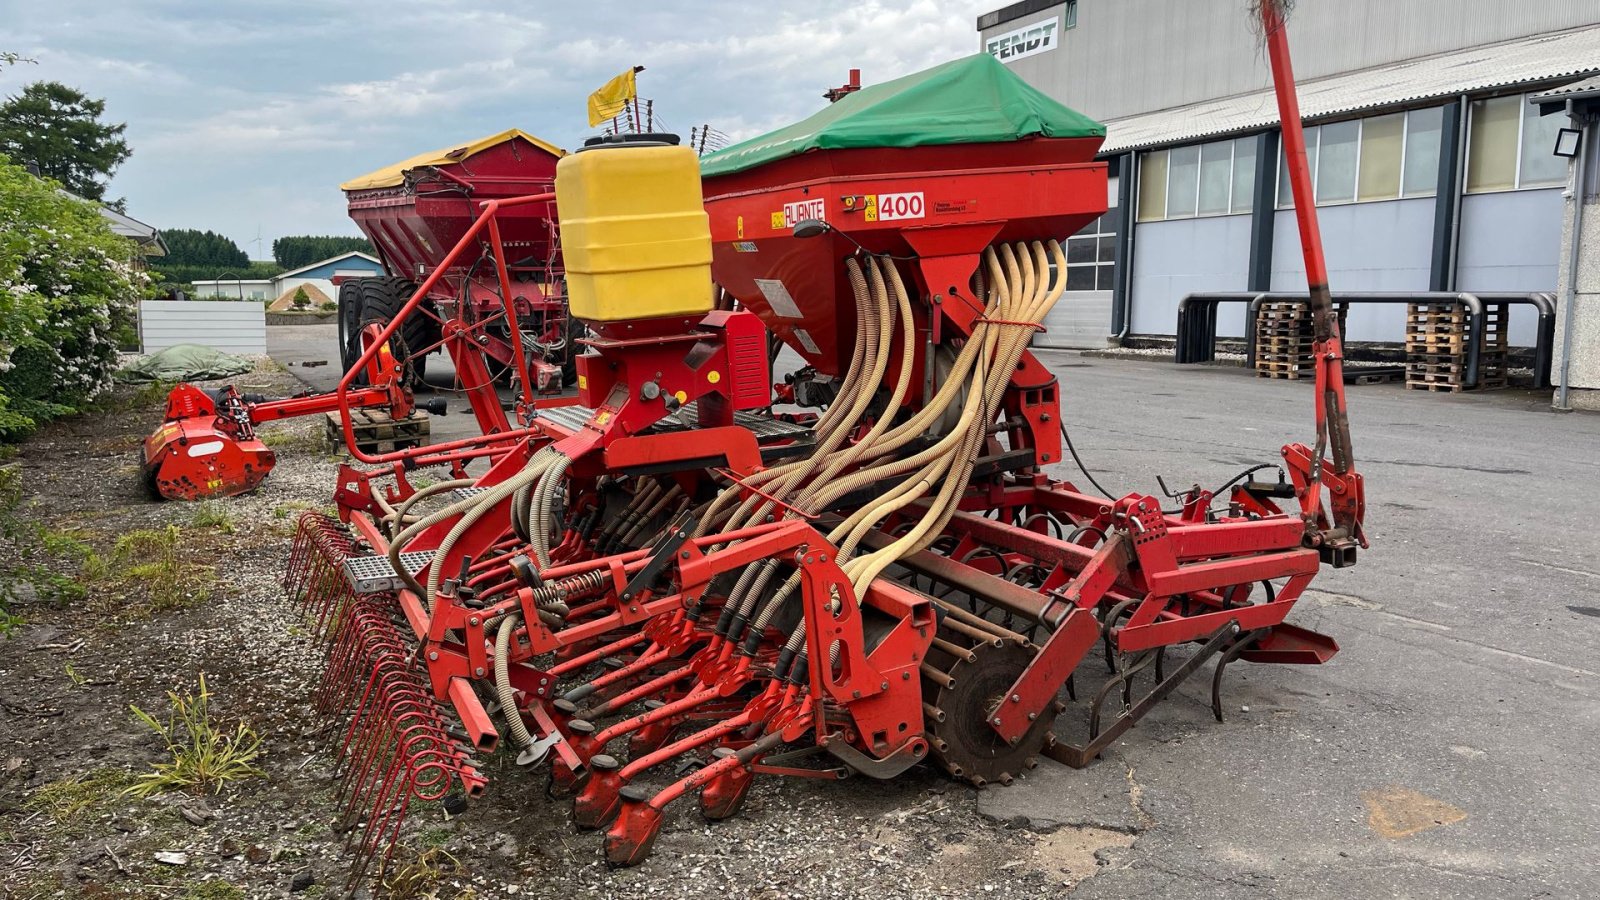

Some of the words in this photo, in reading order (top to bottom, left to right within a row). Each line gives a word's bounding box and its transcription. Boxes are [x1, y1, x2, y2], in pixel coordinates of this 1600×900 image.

[988, 22, 1057, 59] FENDT
[785, 200, 823, 224] ALIANTE
[881, 195, 922, 218] 400
